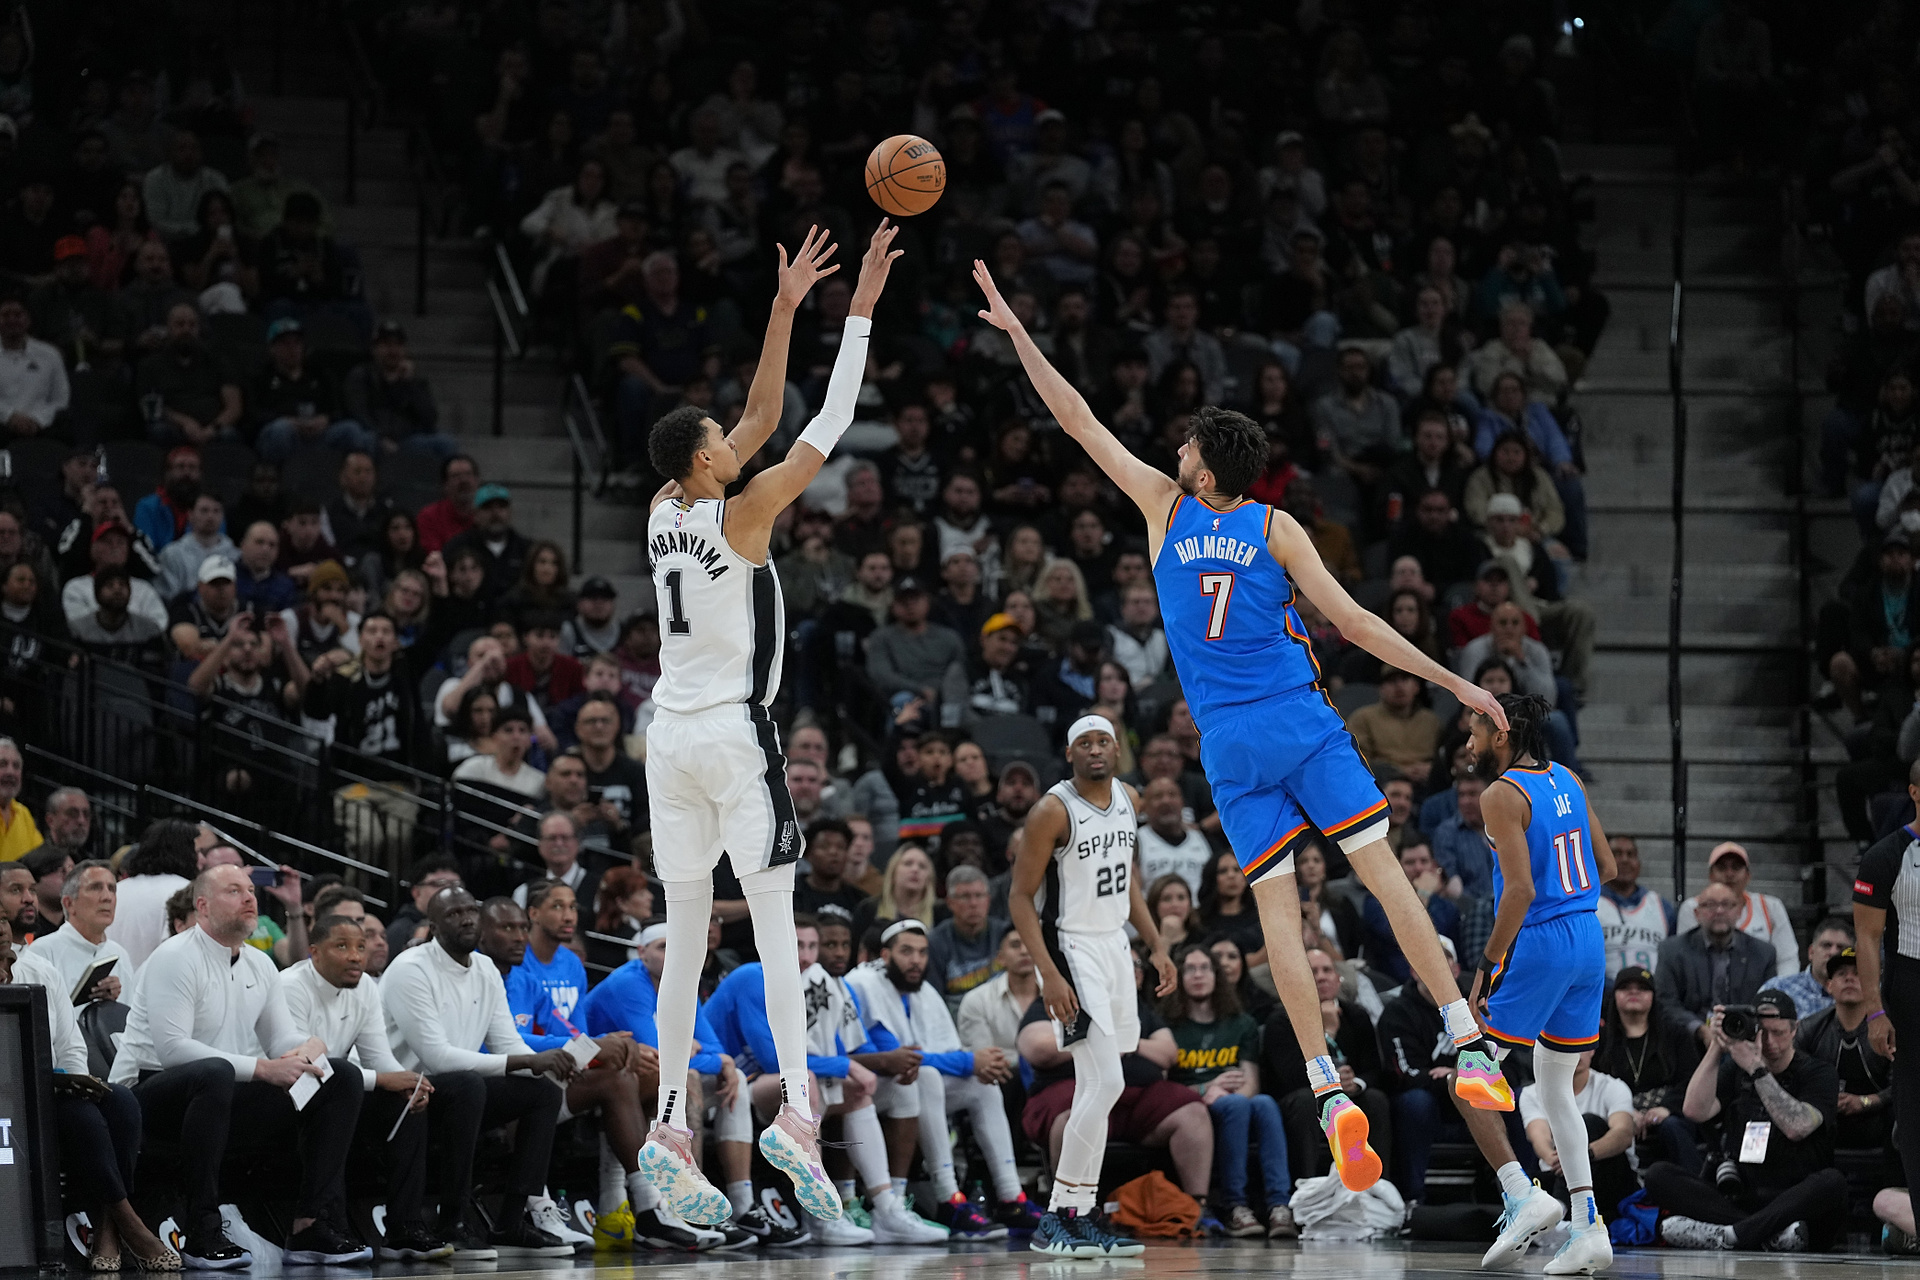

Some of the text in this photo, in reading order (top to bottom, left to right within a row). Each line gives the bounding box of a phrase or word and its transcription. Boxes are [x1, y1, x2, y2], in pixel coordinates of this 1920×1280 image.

[1173, 535, 1259, 567] HOLMGREN
[664, 568, 692, 637] 1
[1199, 572, 1235, 641] 7
[1553, 793, 1572, 817] JOE
[1078, 830, 1135, 860] SPURS
[1553, 828, 1592, 895] 11
[1098, 863, 1127, 898] 22
